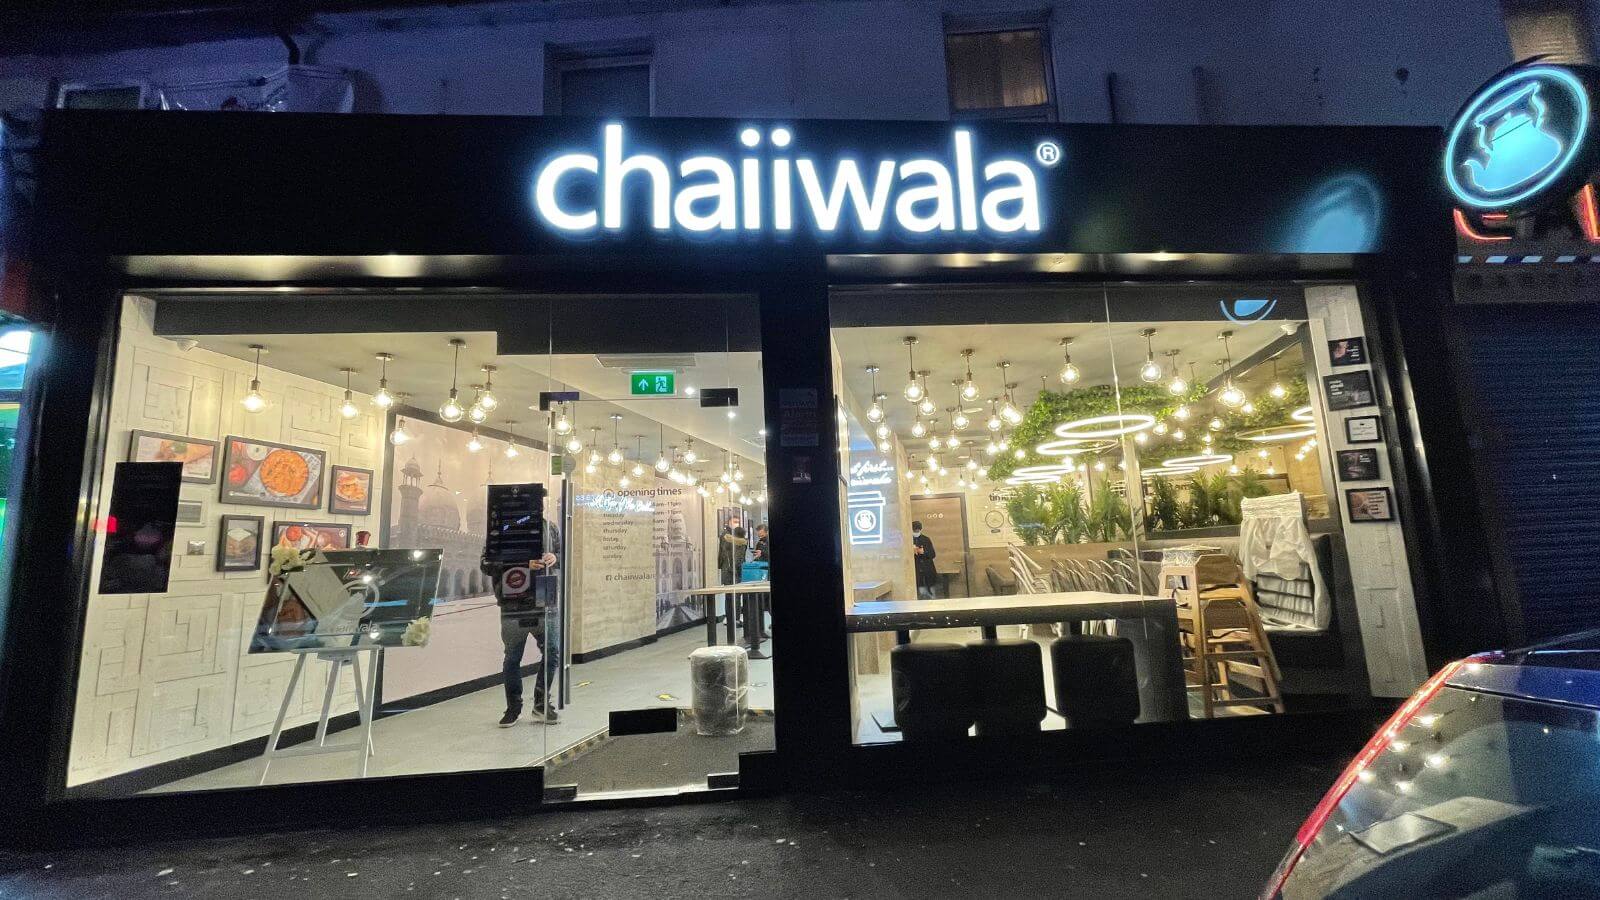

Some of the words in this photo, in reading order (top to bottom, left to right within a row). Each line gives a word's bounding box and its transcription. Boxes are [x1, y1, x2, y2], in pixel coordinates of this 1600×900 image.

[535, 123, 1041, 232] chaiiwala
[618, 488, 655, 498] opening
[657, 487, 682, 496] times
